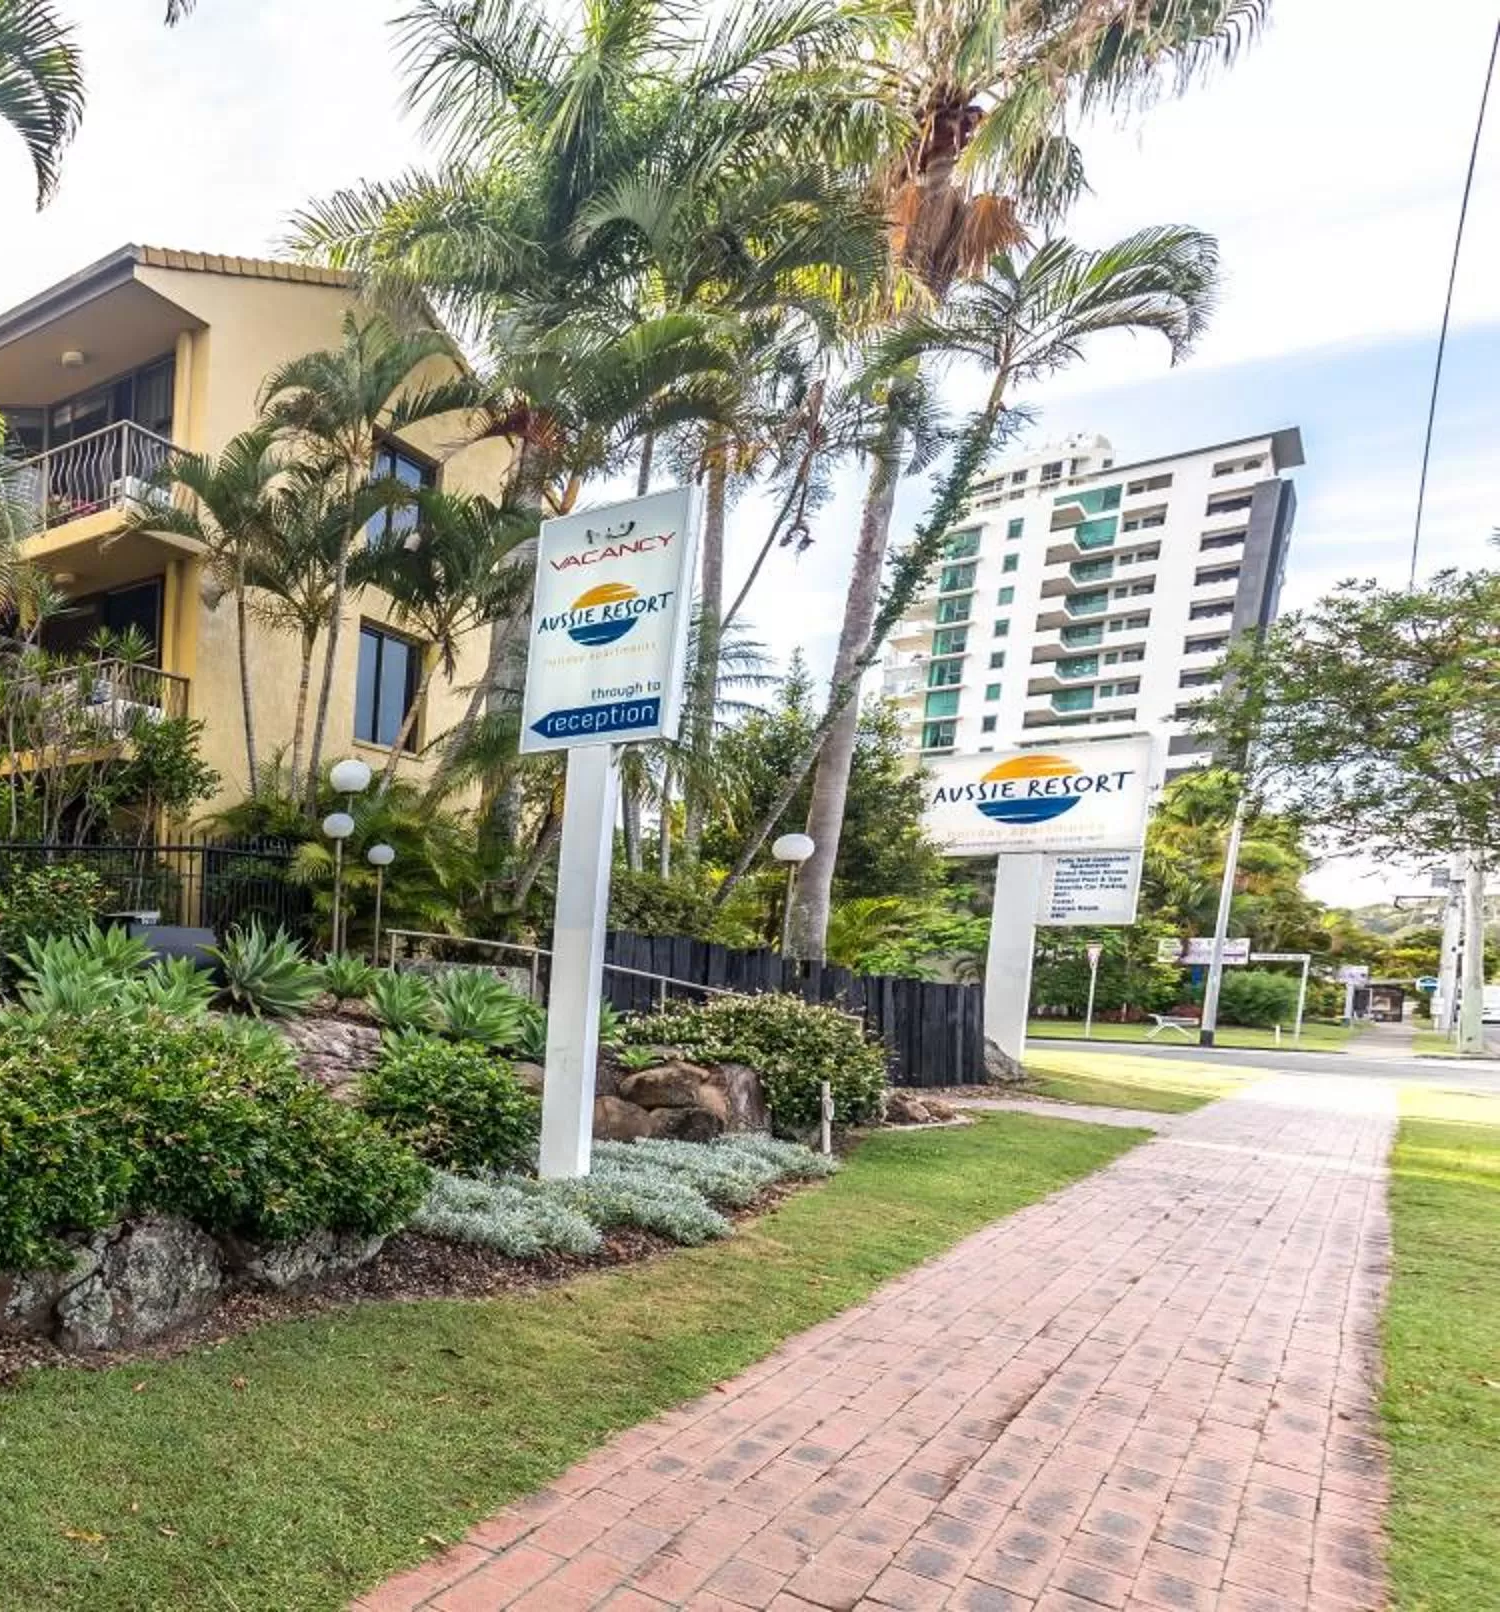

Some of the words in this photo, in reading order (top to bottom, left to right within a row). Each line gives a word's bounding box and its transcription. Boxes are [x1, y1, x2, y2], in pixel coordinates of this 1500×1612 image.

[550, 531, 676, 571] VACANCY
[537, 607, 595, 634] AUSSIE
[602, 591, 674, 623] RESORT
[591, 681, 643, 700] through
[647, 680, 661, 693] to
[547, 703, 654, 733] reception
[933, 780, 1016, 805] AUSSIE
[1028, 771, 1136, 797] RESORT
